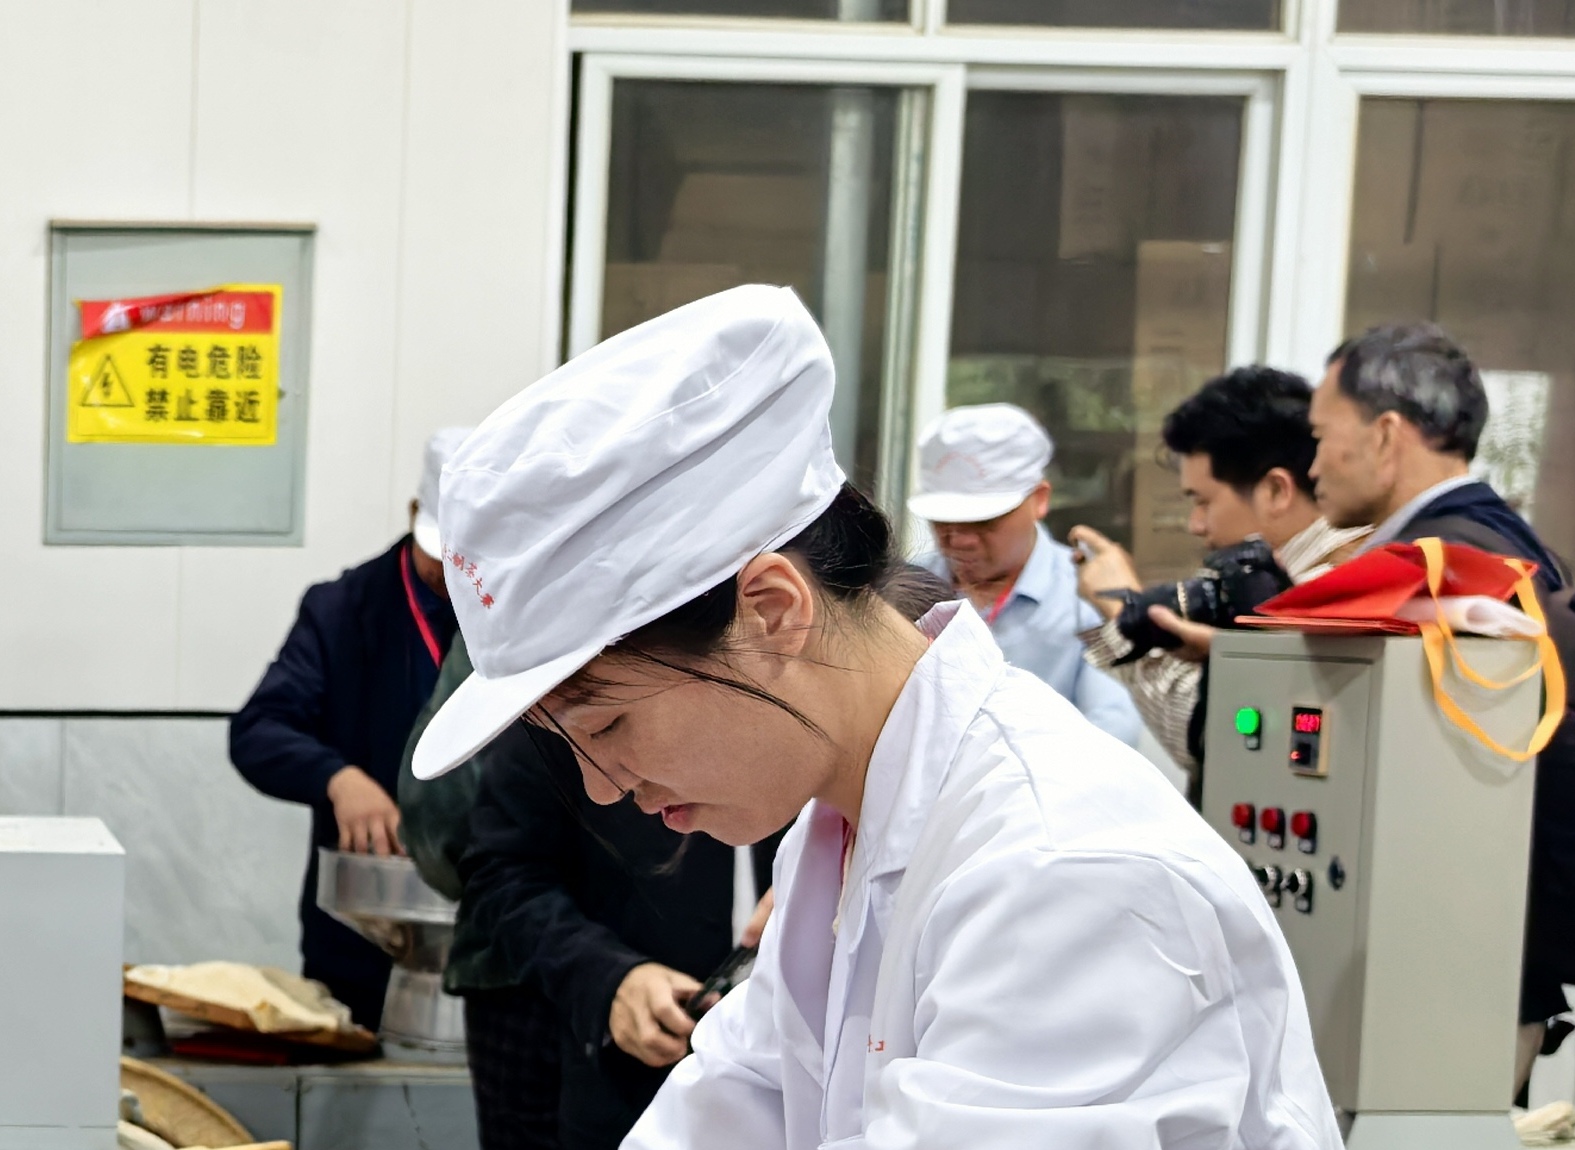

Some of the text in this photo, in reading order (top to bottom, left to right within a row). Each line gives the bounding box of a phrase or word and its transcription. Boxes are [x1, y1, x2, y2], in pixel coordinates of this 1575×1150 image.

[145, 345, 262, 380] 有电危险
[144, 388, 261, 424] 禁止靠近
